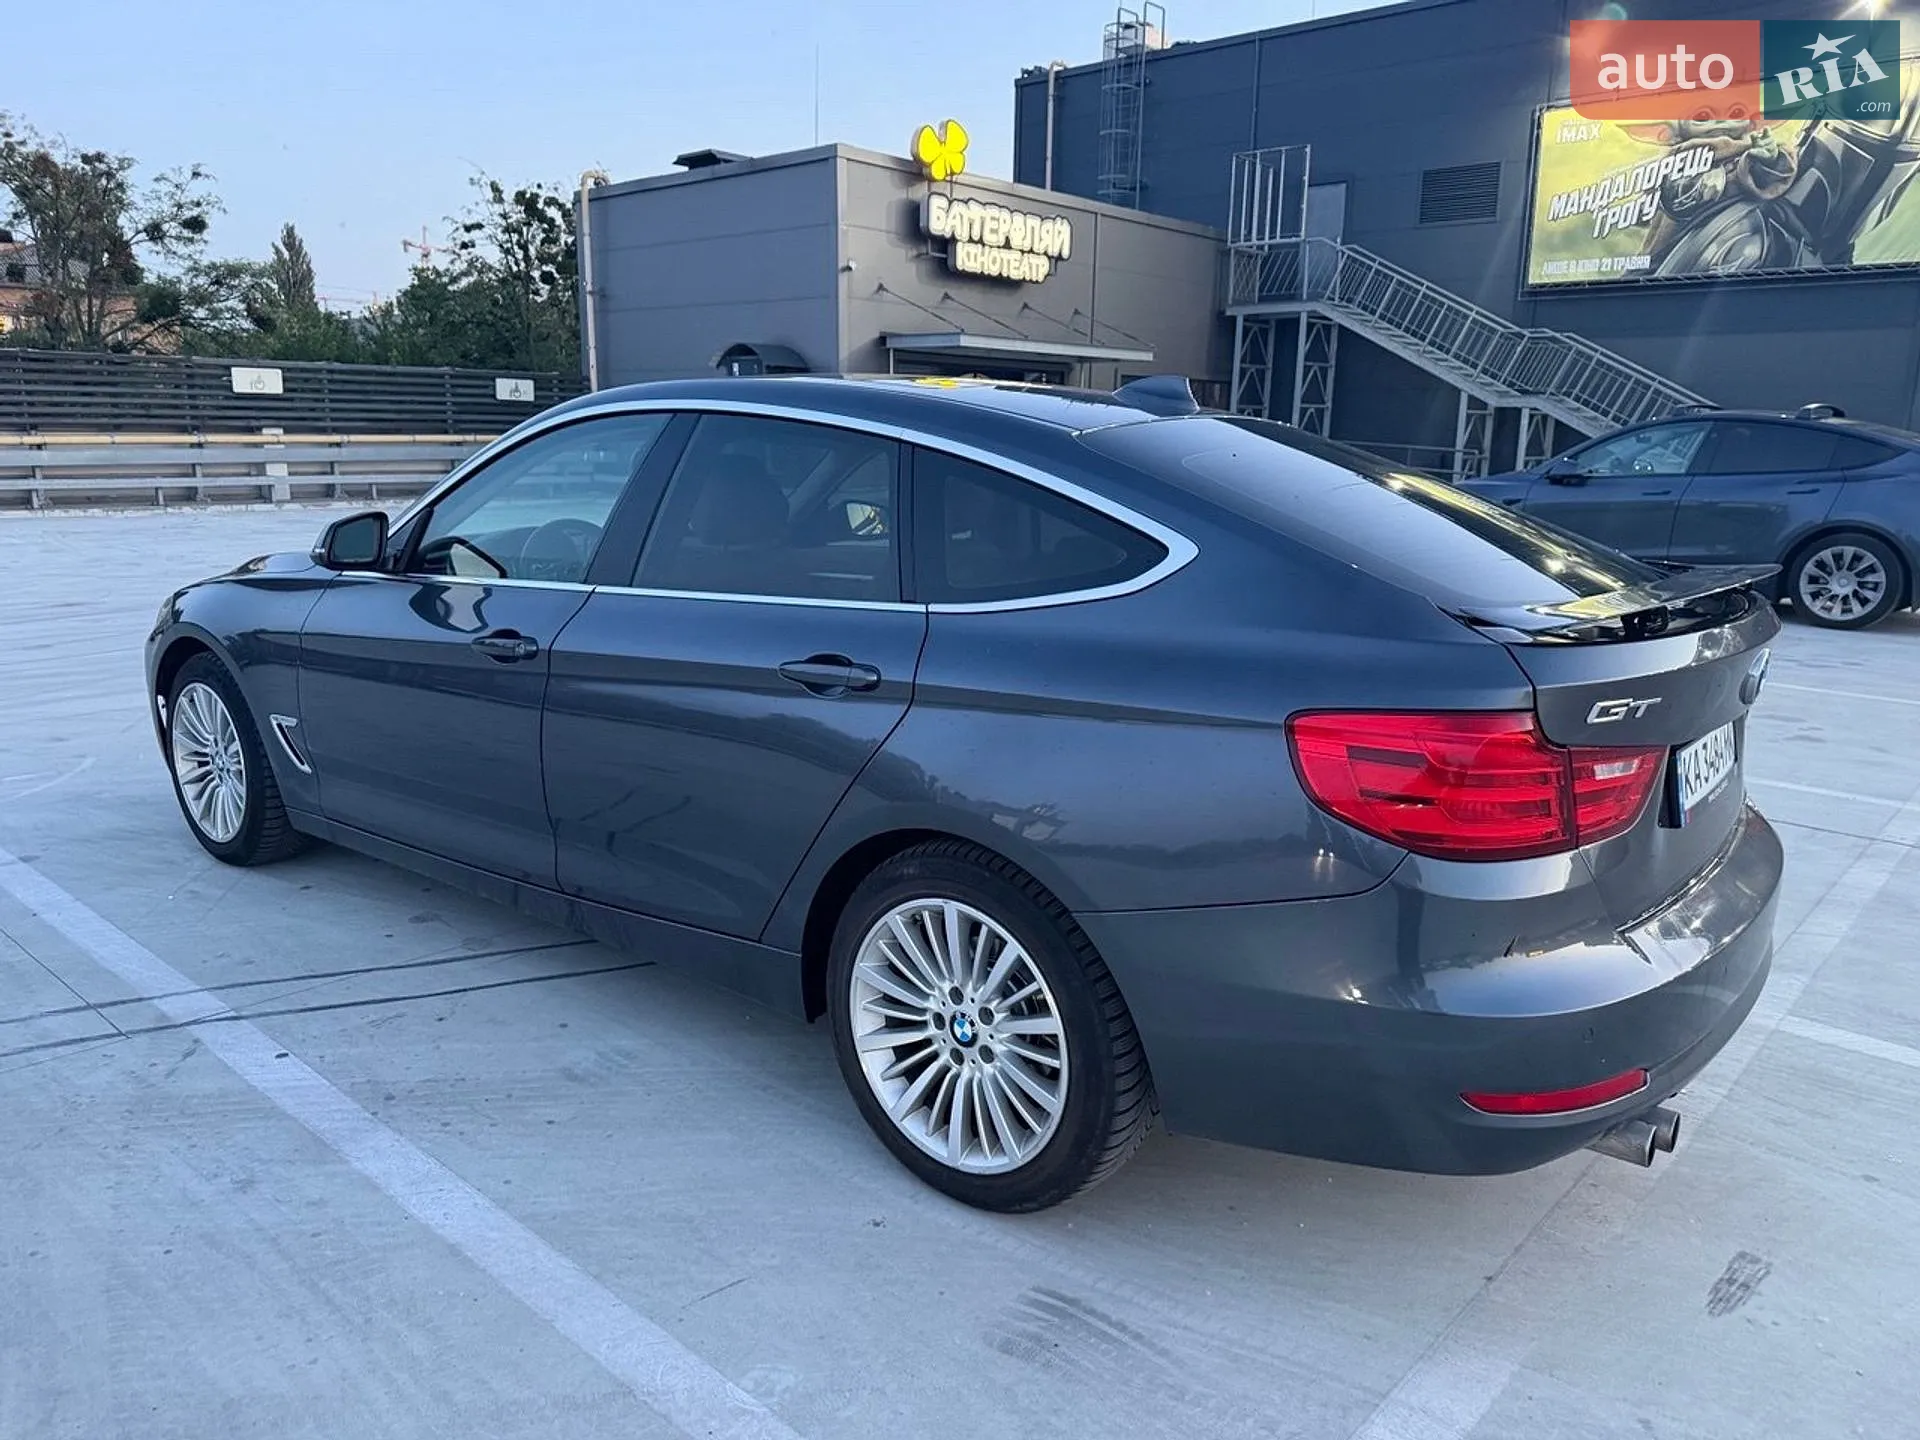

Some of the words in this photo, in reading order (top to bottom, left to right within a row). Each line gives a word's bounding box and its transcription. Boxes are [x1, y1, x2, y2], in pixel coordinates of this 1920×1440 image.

[1555, 122, 1602, 144] IMAX
[1547, 145, 1715, 222] МАНДАЛОРЕЦЬ
[928, 192, 1072, 260] БАТТЕРФЛЯЙ
[955, 241, 1051, 283] КІНОТЕАТР
[1600, 257, 1612, 272] 21
[1586, 697, 1662, 724] GT
